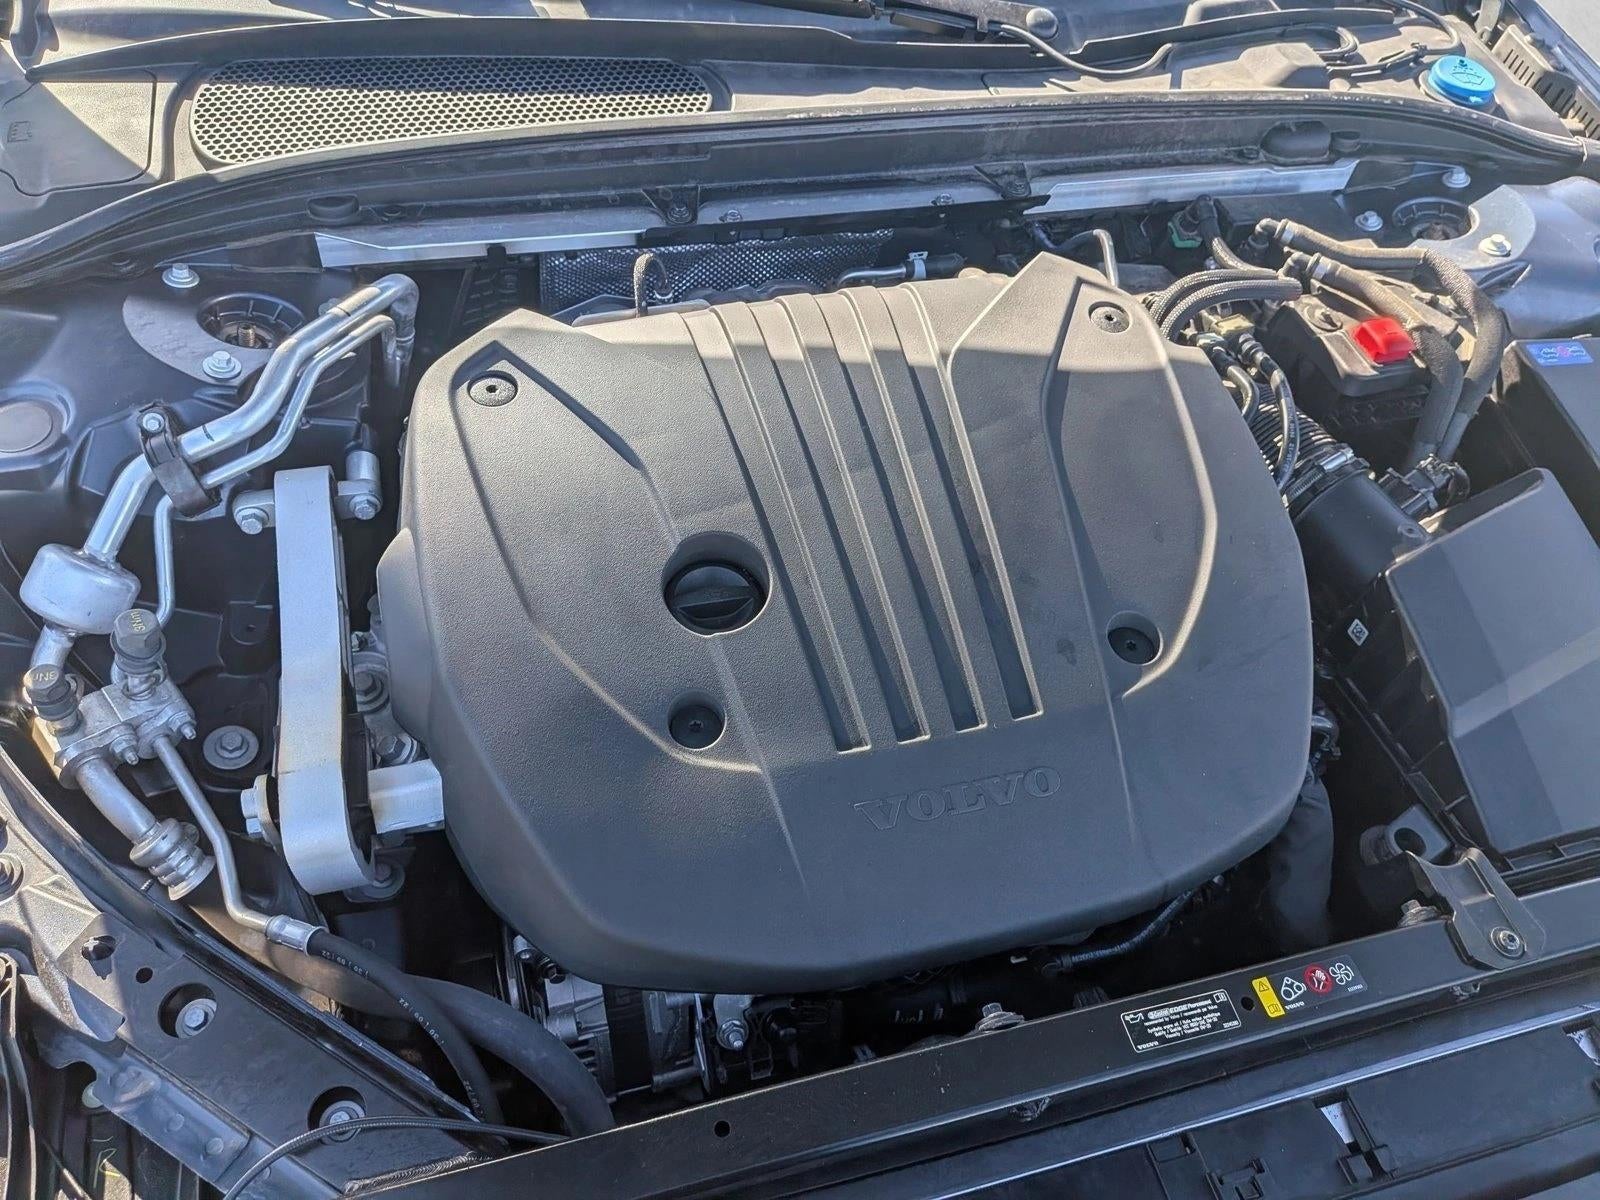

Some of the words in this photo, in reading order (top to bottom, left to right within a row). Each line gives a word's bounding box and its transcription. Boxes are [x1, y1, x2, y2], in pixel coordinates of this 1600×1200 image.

[853, 765, 1062, 830] VOLVO
[1285, 1001, 1305, 1010] VOLVO
[1137, 1041, 1158, 1050] VOLVO
